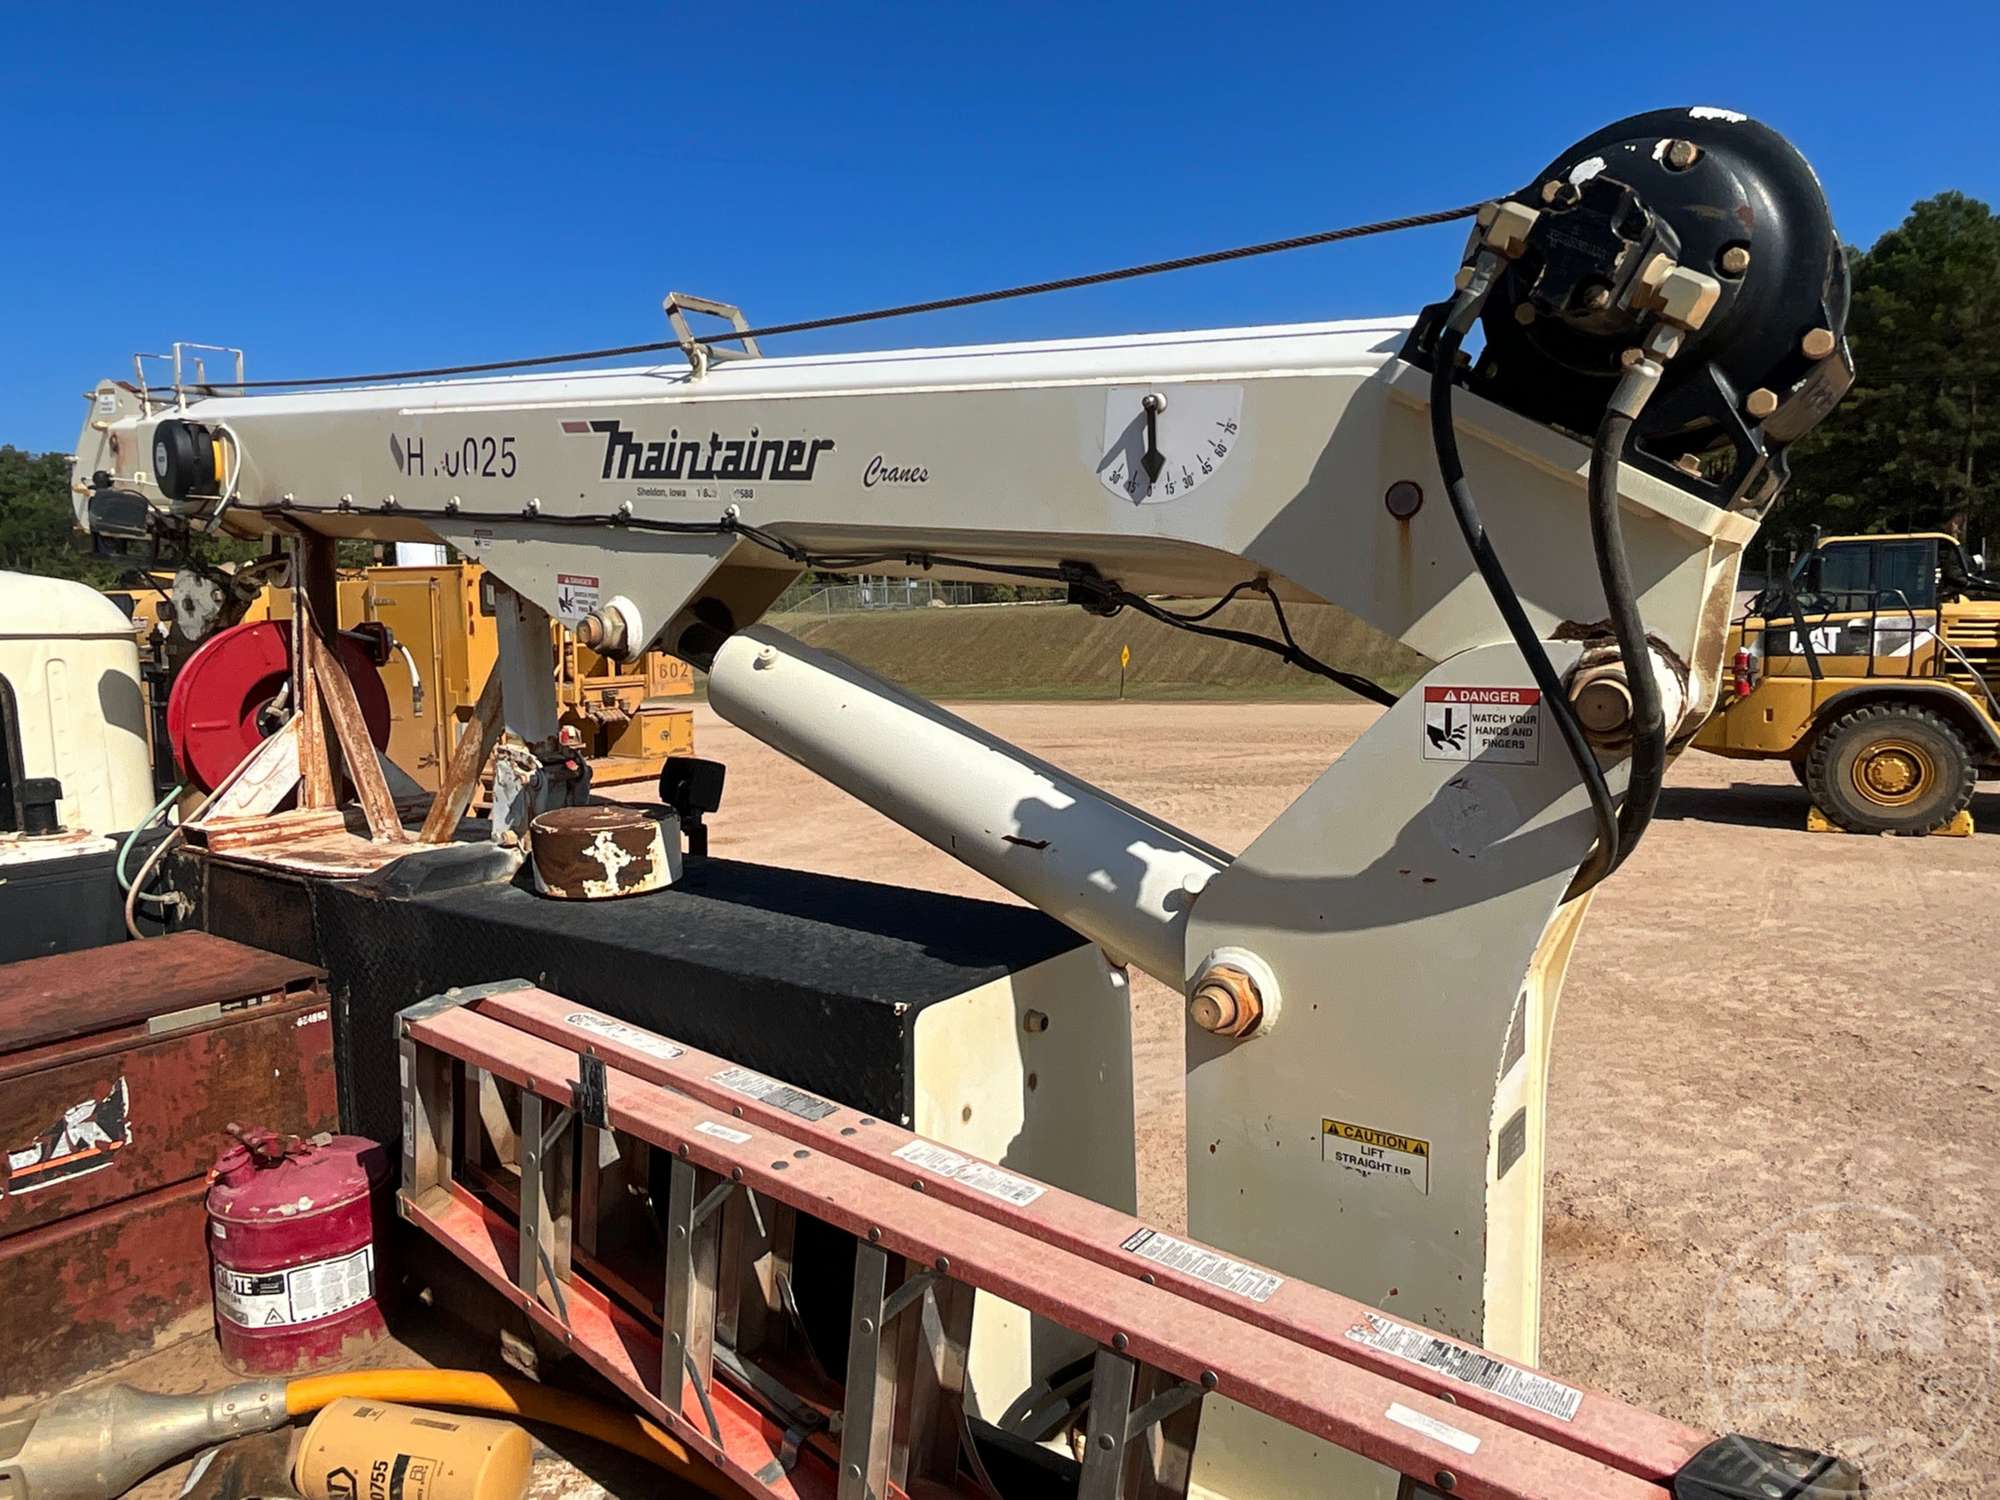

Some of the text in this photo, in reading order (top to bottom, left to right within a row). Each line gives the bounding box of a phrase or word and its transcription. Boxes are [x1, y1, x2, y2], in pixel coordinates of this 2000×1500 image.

[589, 420, 836, 481] Maintainer
[863, 455, 929, 487] Cranes
[669, 487, 687, 498] Iowa
[1789, 626, 1841, 654] CAT
[1460, 690, 1520, 703] DANGER
[1472, 713, 1537, 725] WATCH YOUR
[1475, 727, 1533, 737] HANDS AND
[1482, 738, 1525, 749] FINGERS
[1343, 1126, 1408, 1150] CAUTION
[1360, 1145, 1385, 1159] LIFT
[1335, 1151, 1392, 1173] STRAIGHT
[1395, 1165, 1411, 1176] UP
